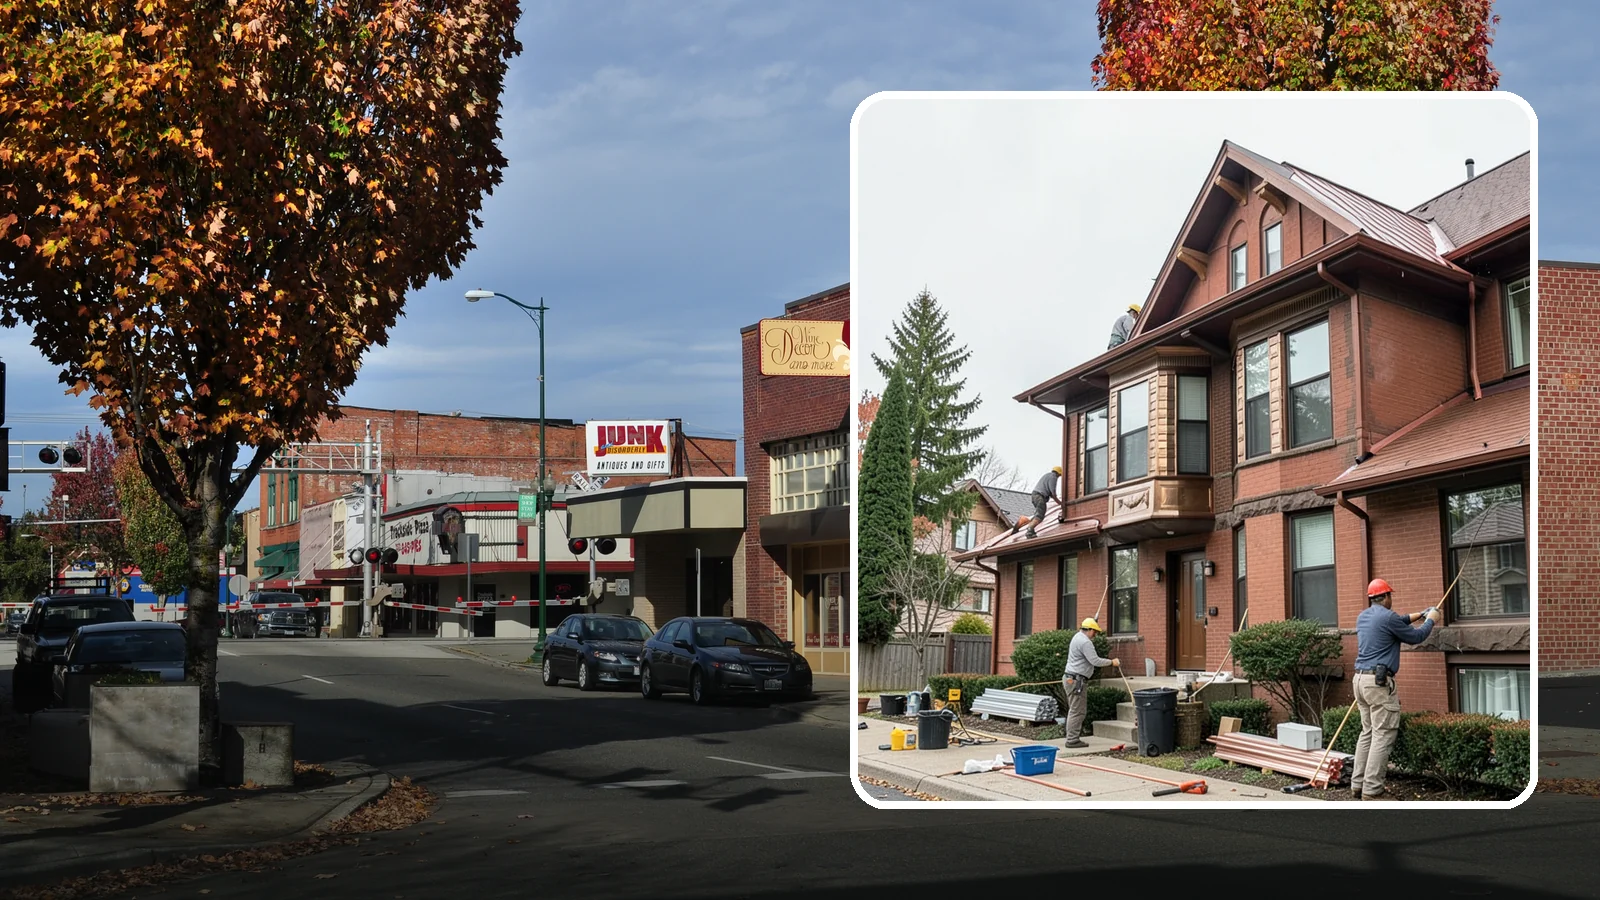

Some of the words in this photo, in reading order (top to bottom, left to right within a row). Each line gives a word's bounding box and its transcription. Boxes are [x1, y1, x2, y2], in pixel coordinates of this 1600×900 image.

[595, 425, 665, 457] JUNK
[607, 446, 646, 454] DISORDERLY
[597, 461, 628, 470] ANTIQUES
[631, 461, 643, 469] AND
[647, 460, 666, 469] GIFTS
[390, 521, 413, 540] Trackside
[414, 519, 429, 535] Pizza
